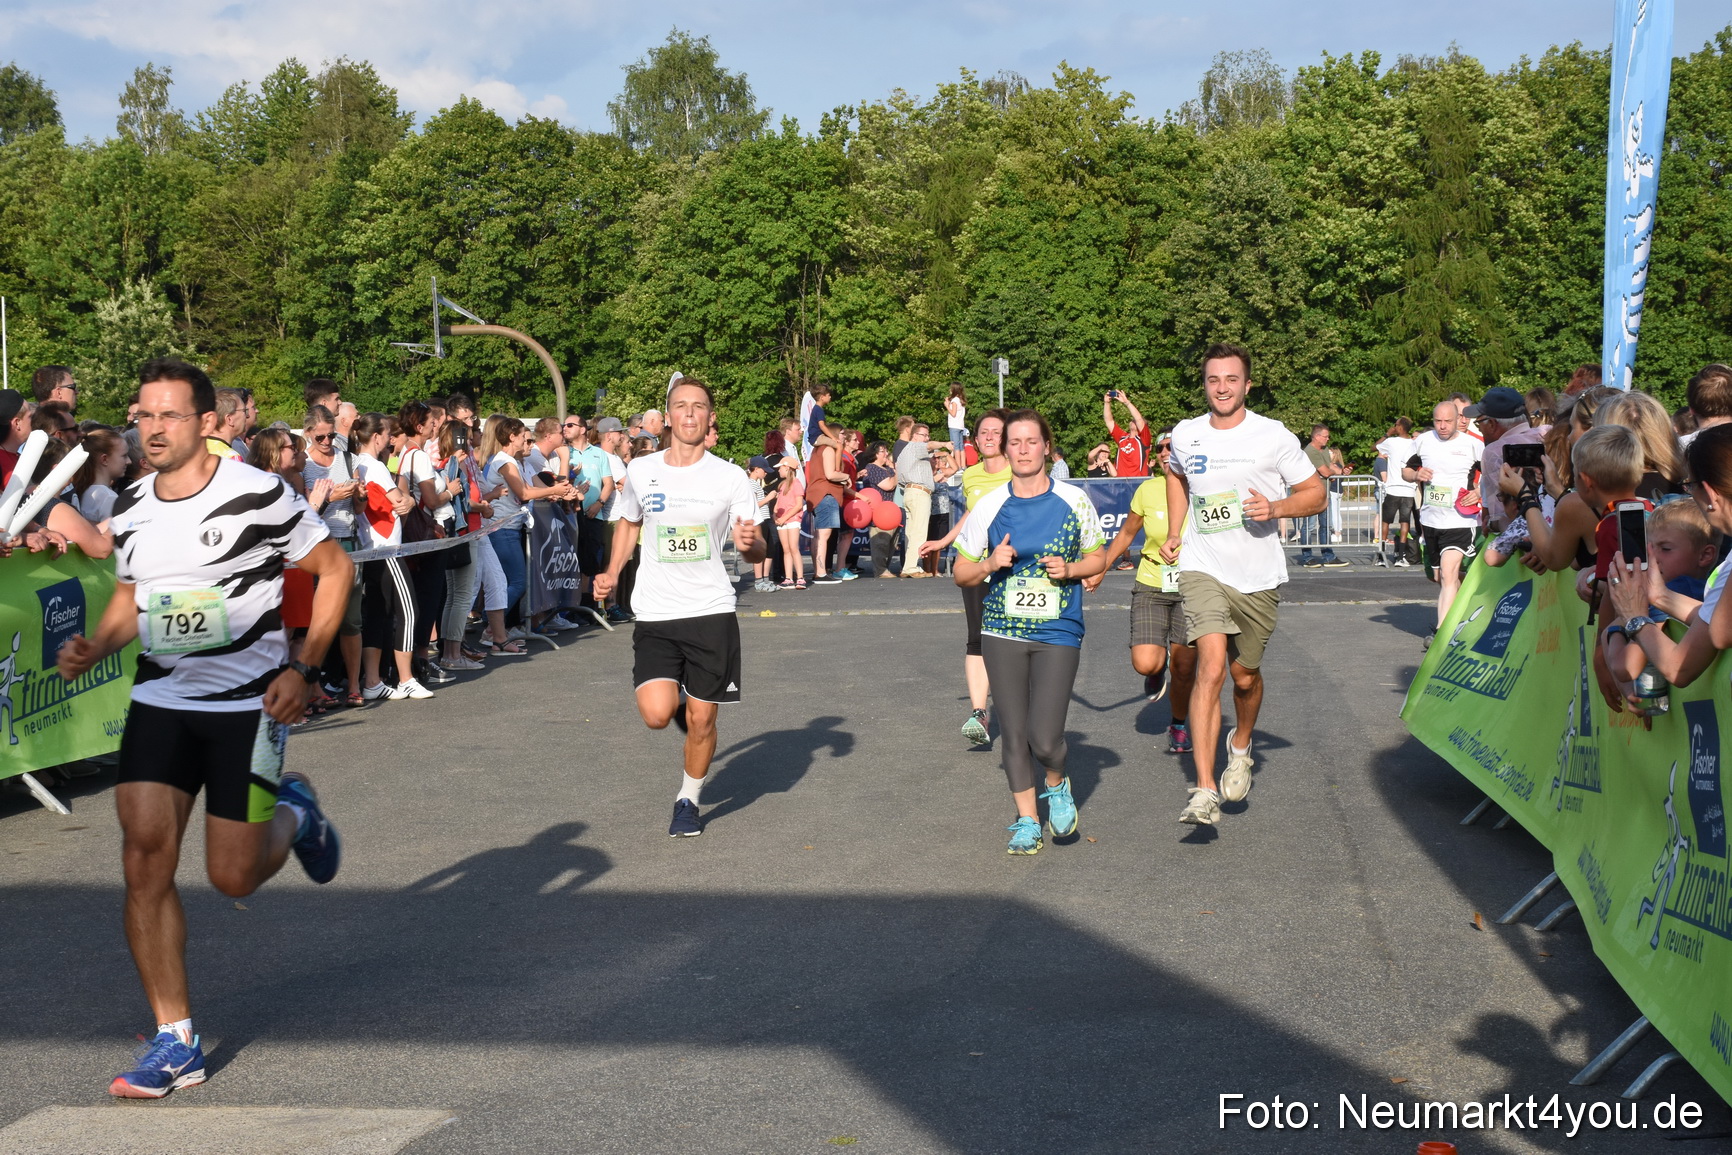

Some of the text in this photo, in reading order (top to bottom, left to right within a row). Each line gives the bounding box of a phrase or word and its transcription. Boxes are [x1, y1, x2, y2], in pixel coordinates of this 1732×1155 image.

[1429, 491, 1446, 501] 967
[1200, 506, 1231, 523] 346
[668, 538, 697, 552] 348
[545, 544, 581, 574] Fisch
[1166, 571, 1180, 583] 12
[1015, 592, 1047, 607] 223
[51, 604, 80, 626] Fischer
[1498, 601, 1522, 616] Fischer
[53, 618, 78, 634] AUTOMOBILE
[162, 612, 208, 636] 792
[1434, 641, 1529, 699] firmenlauf
[24, 702, 73, 737] neumarkt
[1694, 748, 1716, 775] Fischer
[1695, 780, 1714, 791] AUTOMOBILE
[1663, 928, 1705, 965] neumarkt
